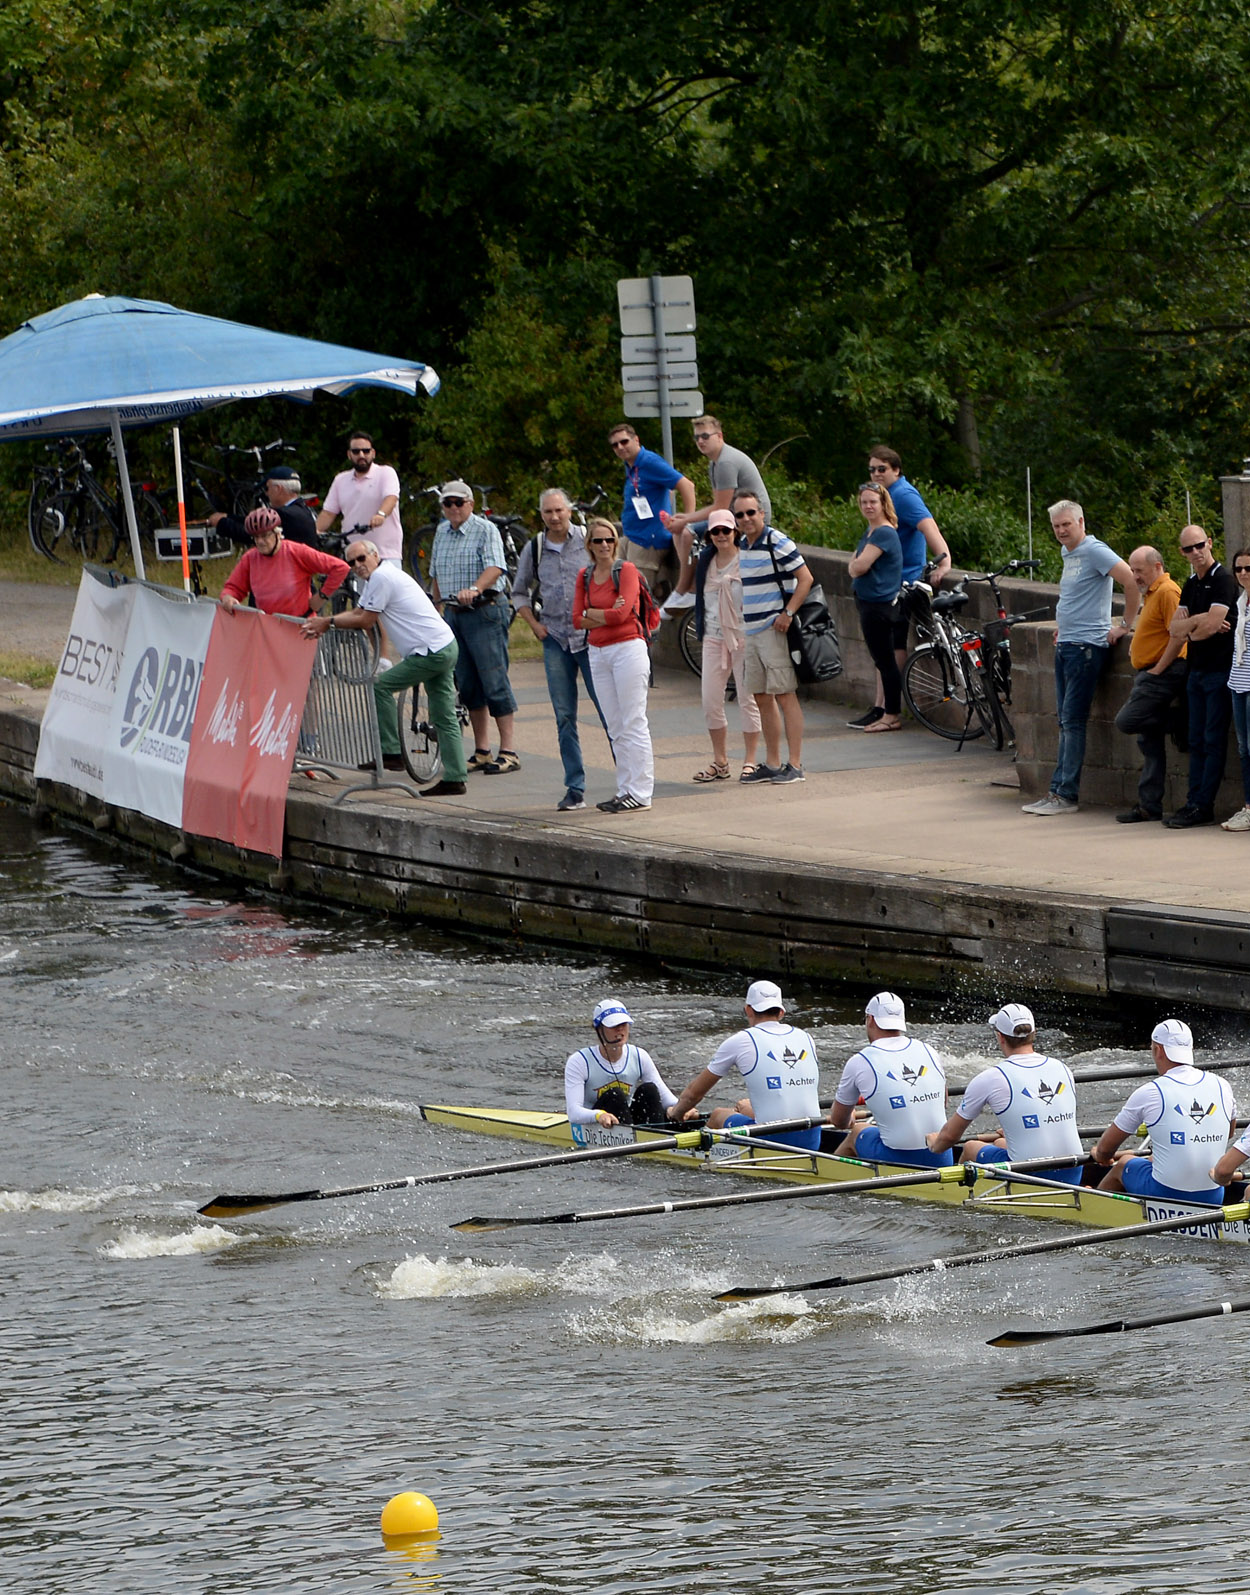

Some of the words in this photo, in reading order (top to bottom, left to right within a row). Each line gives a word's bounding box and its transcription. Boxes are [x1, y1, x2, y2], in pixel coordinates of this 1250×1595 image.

[786, 1077, 816, 1087] -Achter
[909, 1090, 941, 1105] -Achter
[1043, 1111, 1074, 1125] -Achter
[585, 1129, 597, 1144] Die
[598, 1130, 633, 1147] Techniker
[1190, 1133, 1223, 1143] -Achter
